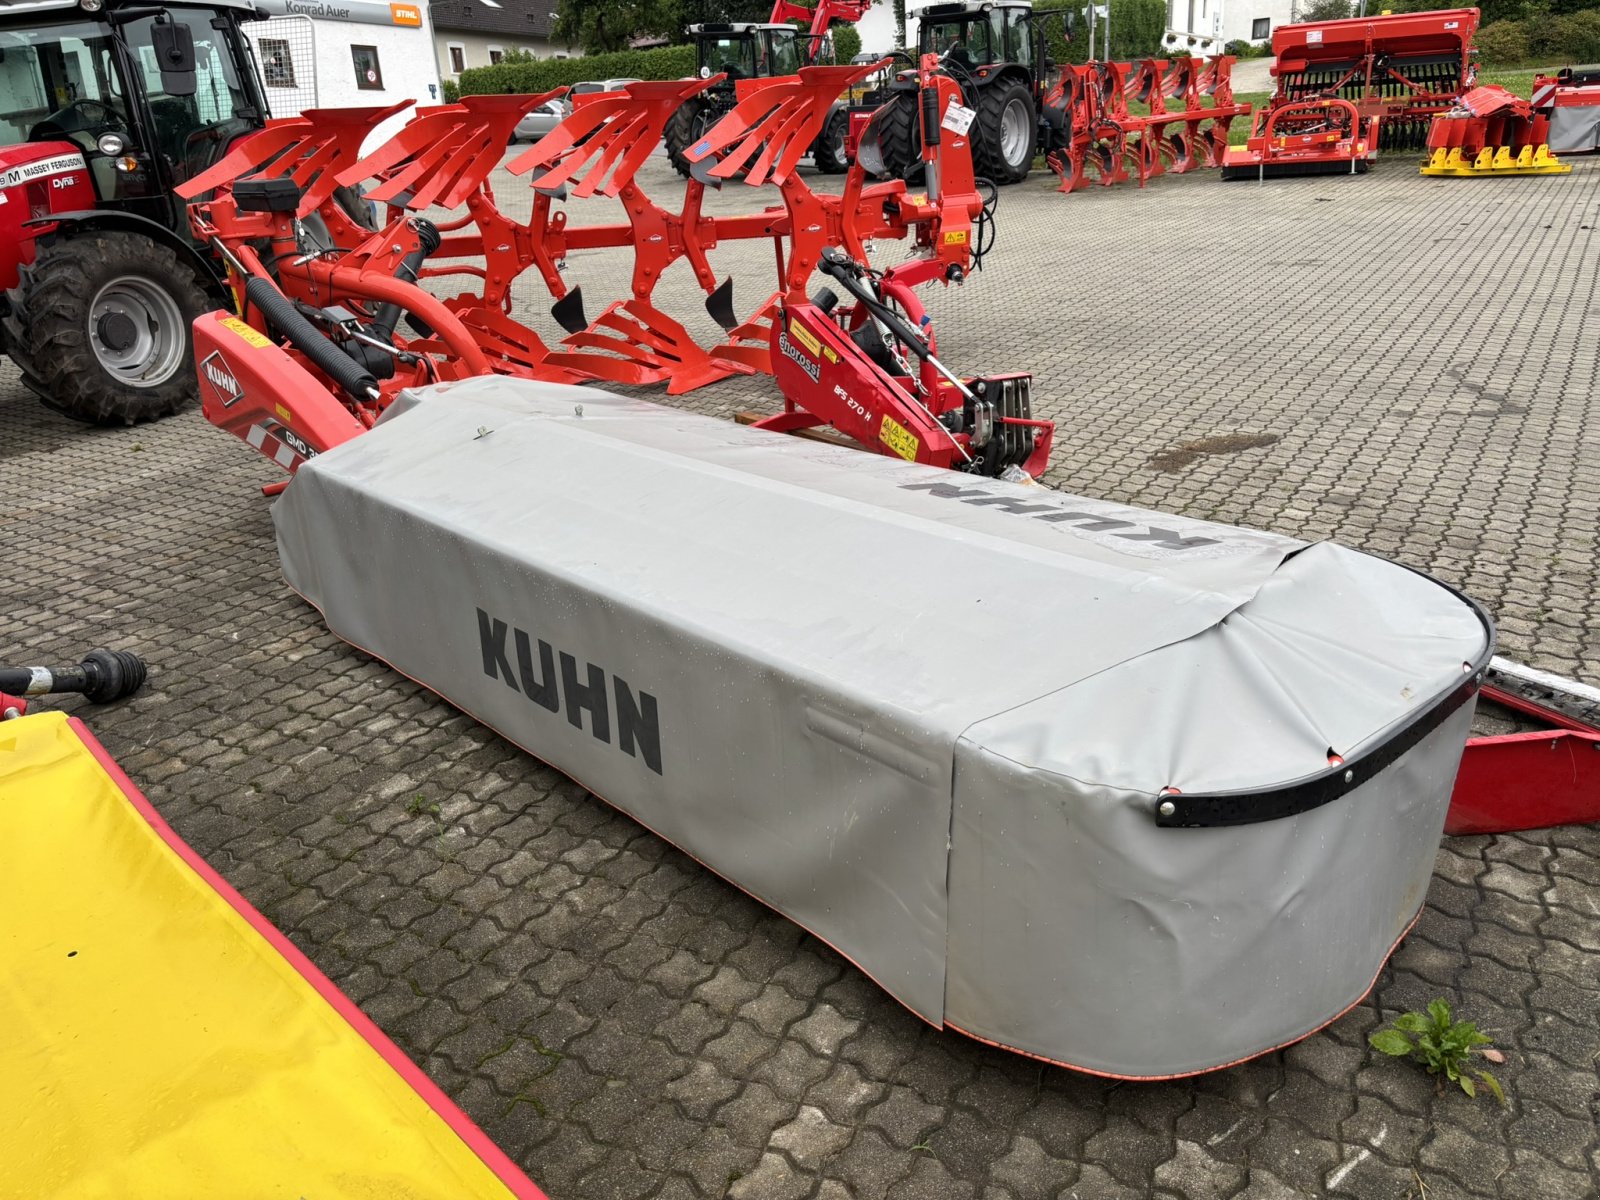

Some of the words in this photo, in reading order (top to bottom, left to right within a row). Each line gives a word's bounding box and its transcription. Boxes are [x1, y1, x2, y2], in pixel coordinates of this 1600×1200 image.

[285, 0, 325, 16] Konrad
[326, 4, 351, 18] Auer
[395, 9, 418, 19] STIHL
[8, 170, 21, 183] M
[23, 162, 50, 177] MASSEY
[51, 157, 83, 171] FERGUSON
[779, 333, 821, 378] enorossi
[206, 362, 237, 396] KUHN
[834, 384, 848, 401] BFS
[847, 398, 865, 415] 270
[865, 412, 872, 421] H
[285, 430, 306, 455] GMD
[896, 482, 1223, 550] KUHN
[476, 607, 663, 776] KUHN
